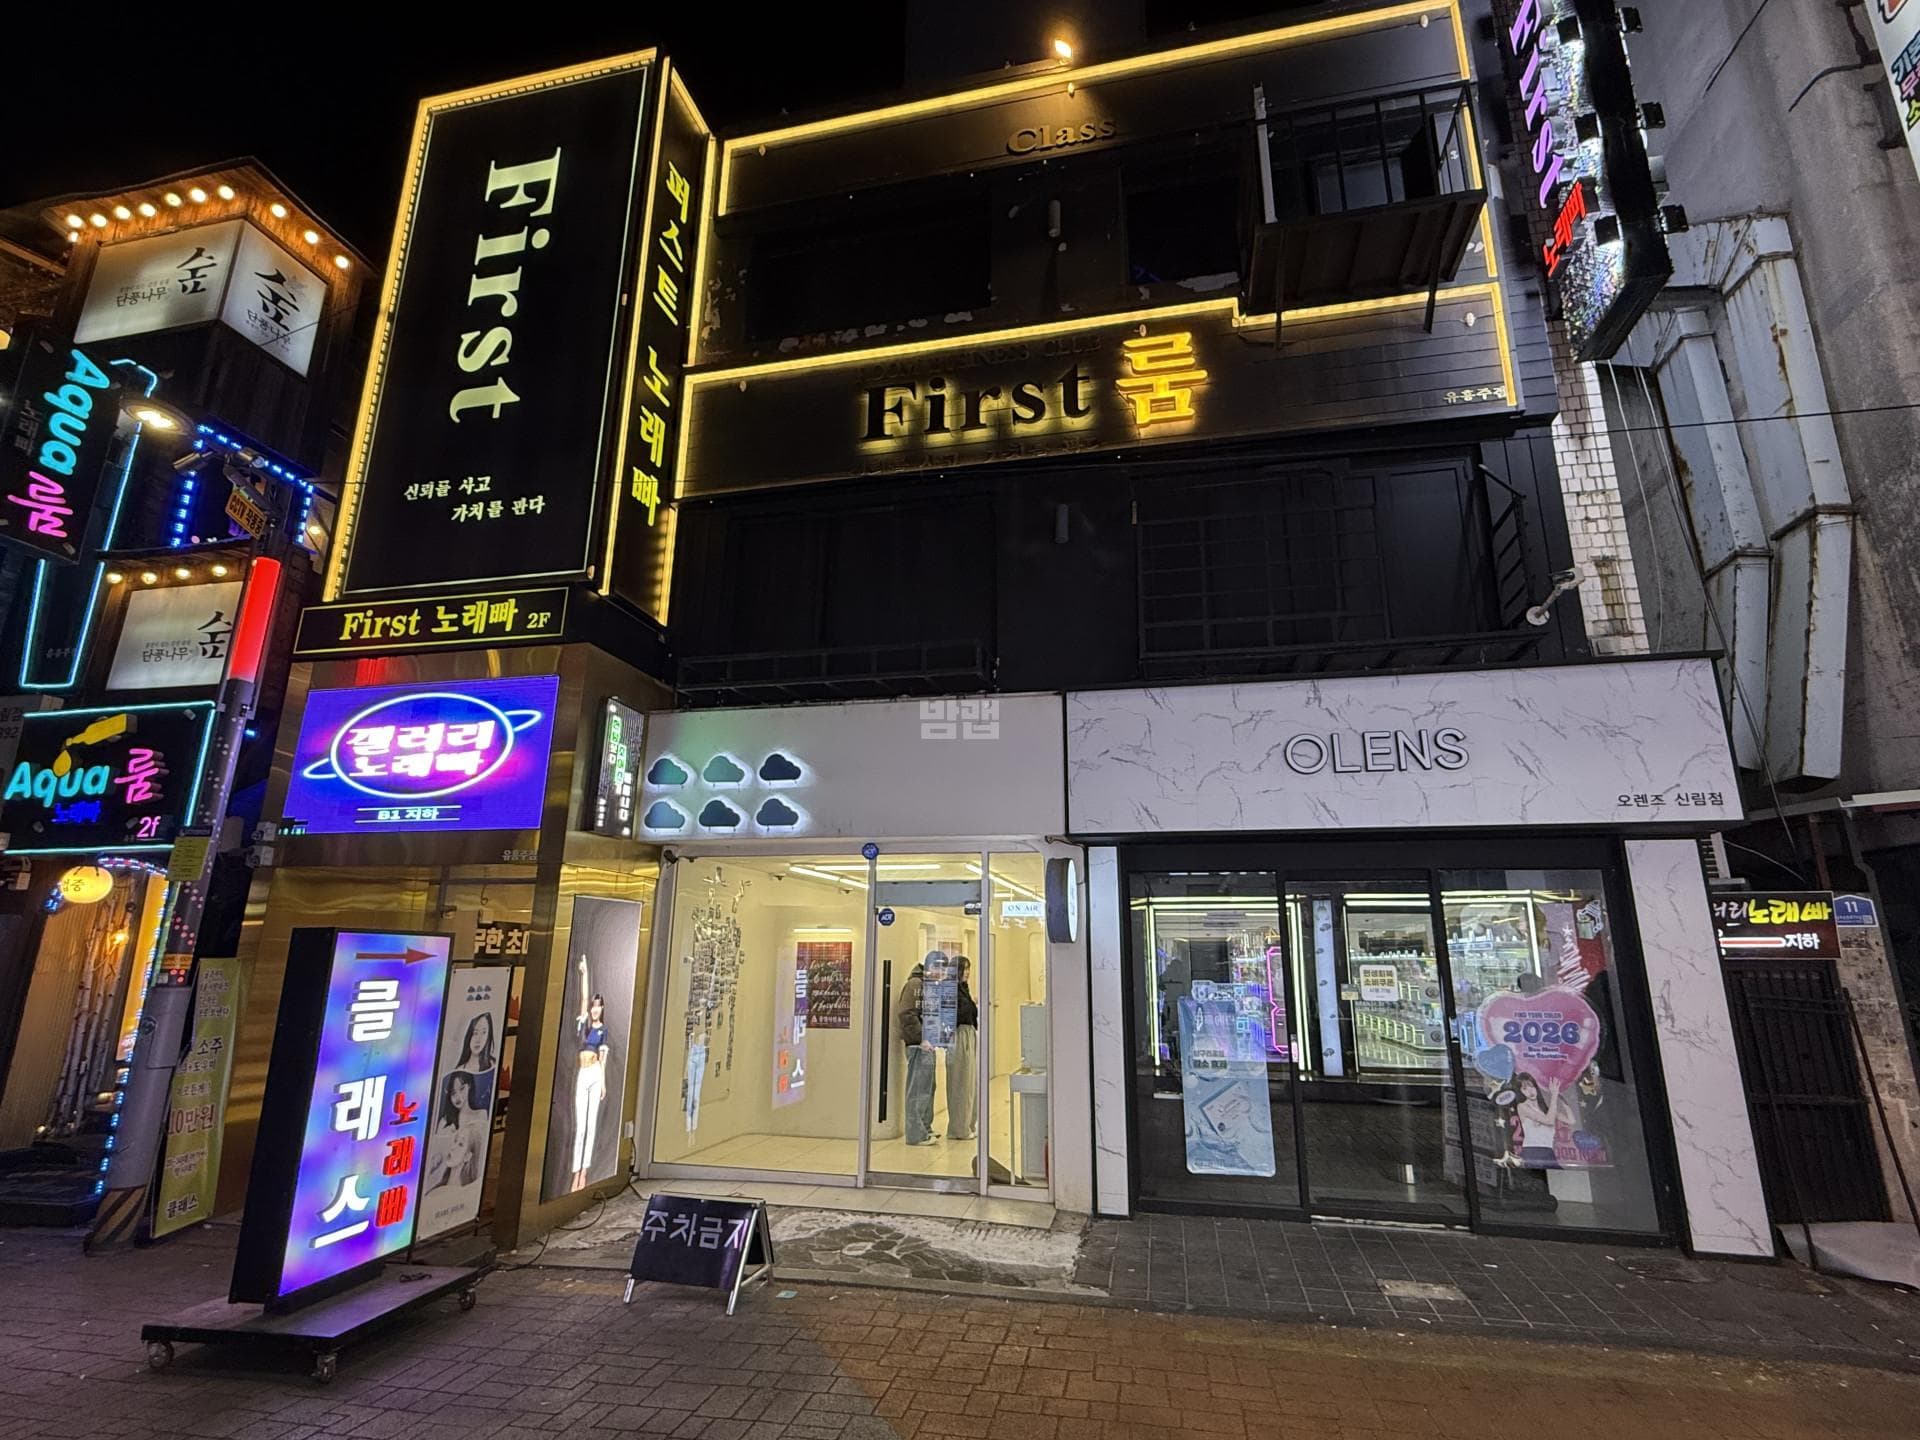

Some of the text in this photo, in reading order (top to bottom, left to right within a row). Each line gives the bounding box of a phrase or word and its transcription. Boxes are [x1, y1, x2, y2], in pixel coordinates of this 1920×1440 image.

[1509, 0, 1564, 208] First
[1006, 117, 1116, 155] Class
[449, 146, 561, 423] First
[1116, 330, 1207, 427] 룸
[39, 349, 110, 476] Aqua
[861, 364, 1091, 440] First
[632, 345, 670, 527] 노래빠
[7, 471, 74, 538] 룸
[403, 476, 491, 501] 신뢰를 사고
[451, 496, 546, 522] 가치를 판다
[339, 598, 552, 641] First 노래빠 2F
[143, 647, 189, 662] 단풍나무
[346, 719, 496, 756] 갤러리
[1284, 727, 1470, 774] OLENS
[3, 748, 159, 808] Aqua 룸
[348, 750, 485, 778] 노래빠
[378, 807, 440, 820] B1 지하
[1616, 790, 1725, 808] 오렌즈 신림점
[881, 913, 893, 921] ADT
[1007, 903, 1039, 912] ON AIR
[1748, 899, 1832, 924] 노래빠
[1844, 901, 1858, 913] 11
[1785, 933, 1820, 949] 지하
[197, 1037, 222, 1055] 소주
[1503, 1021, 1580, 1044] 2026
[168, 1104, 216, 1135] 10만원
[314, 979, 401, 1248] 클래스
[375, 1092, 420, 1229] 노래빠
[644, 1209, 749, 1252] 주차금지
